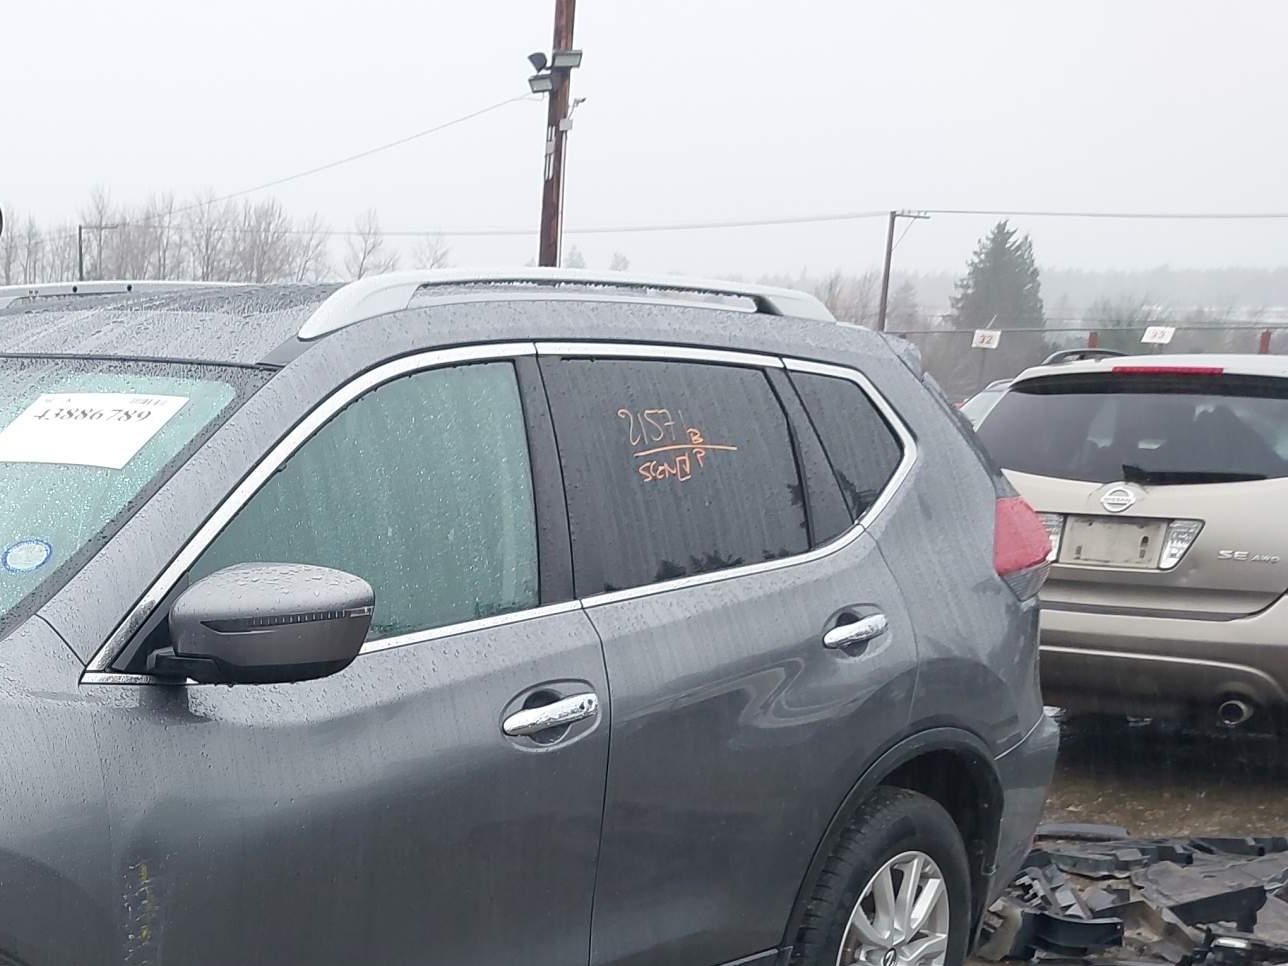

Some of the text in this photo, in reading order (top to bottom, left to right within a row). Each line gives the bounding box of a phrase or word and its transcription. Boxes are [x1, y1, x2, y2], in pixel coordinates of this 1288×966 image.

[33, 407, 152, 422] 43886789
[1217, 550, 1281, 565] SE AWD
